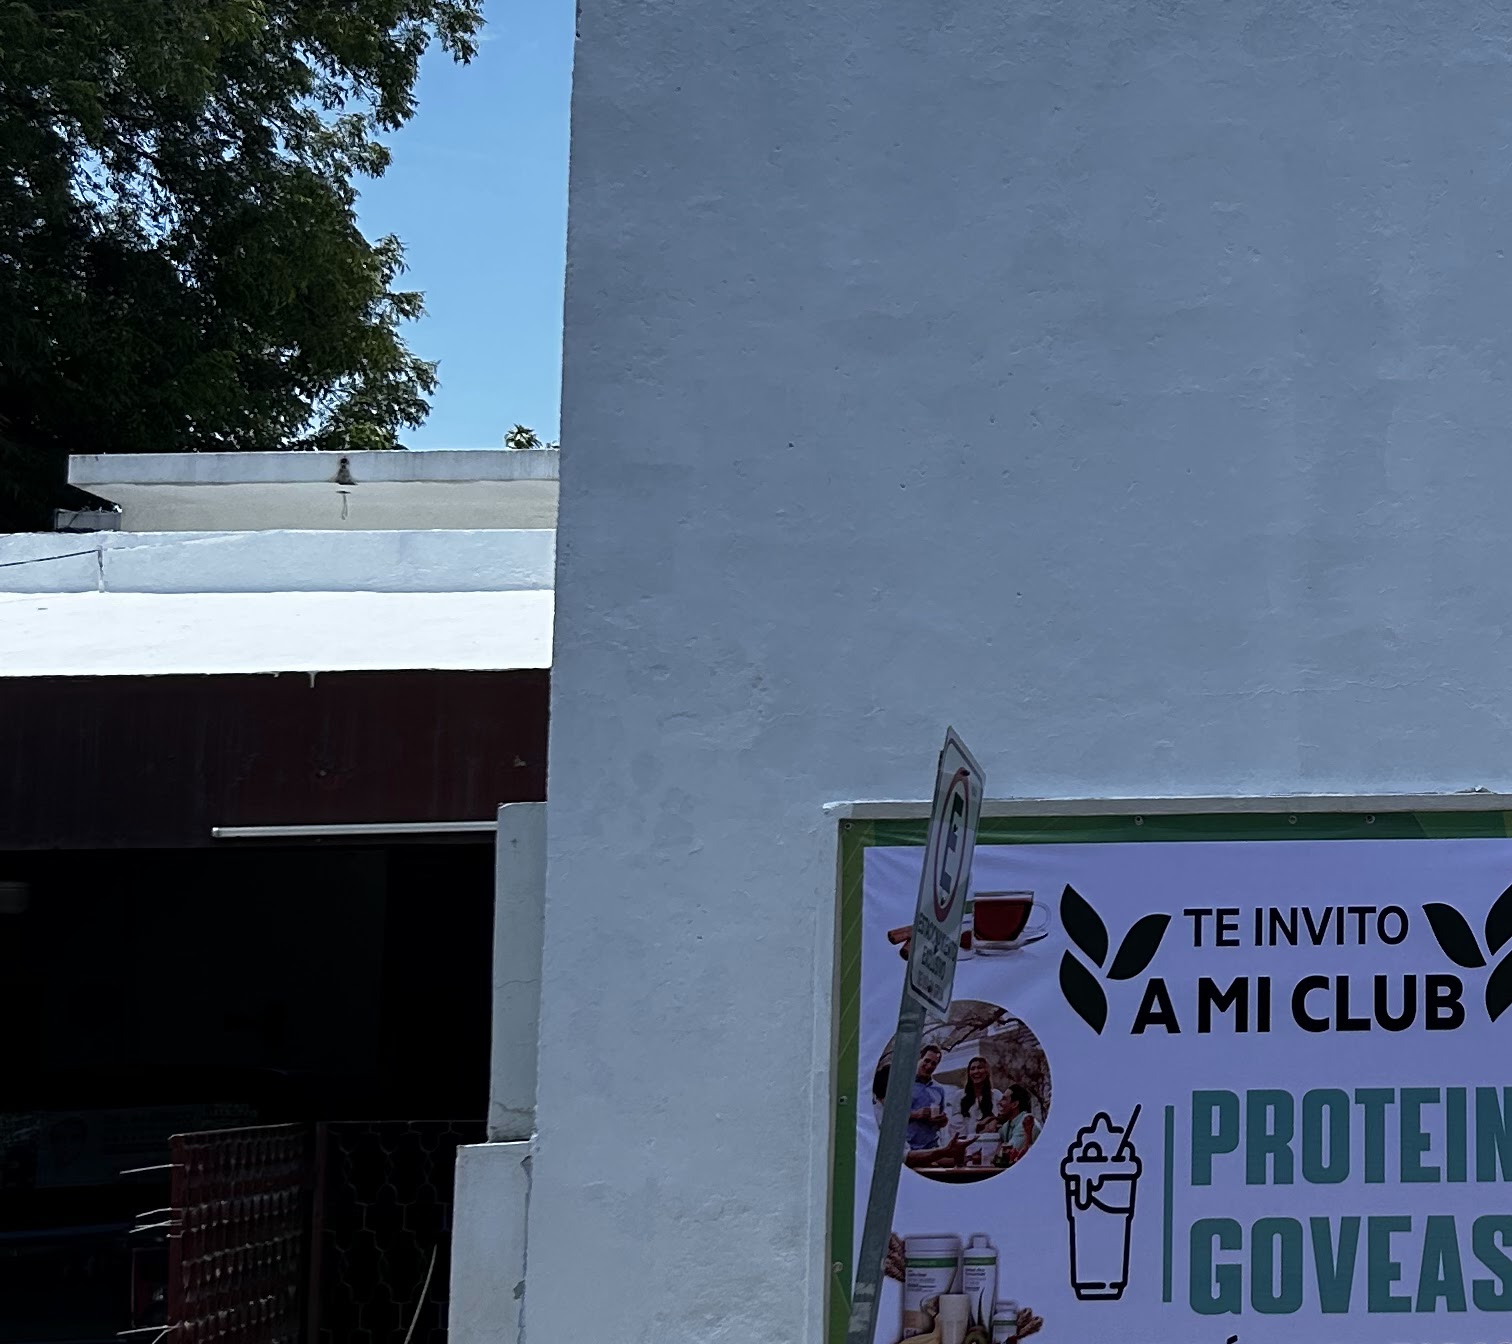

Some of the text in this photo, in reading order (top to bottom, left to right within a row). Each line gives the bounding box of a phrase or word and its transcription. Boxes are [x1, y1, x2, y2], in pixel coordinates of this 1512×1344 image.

[1183, 905, 1409, 948] TE INVITO
[1130, 974, 1466, 1035] A MI CLUB
